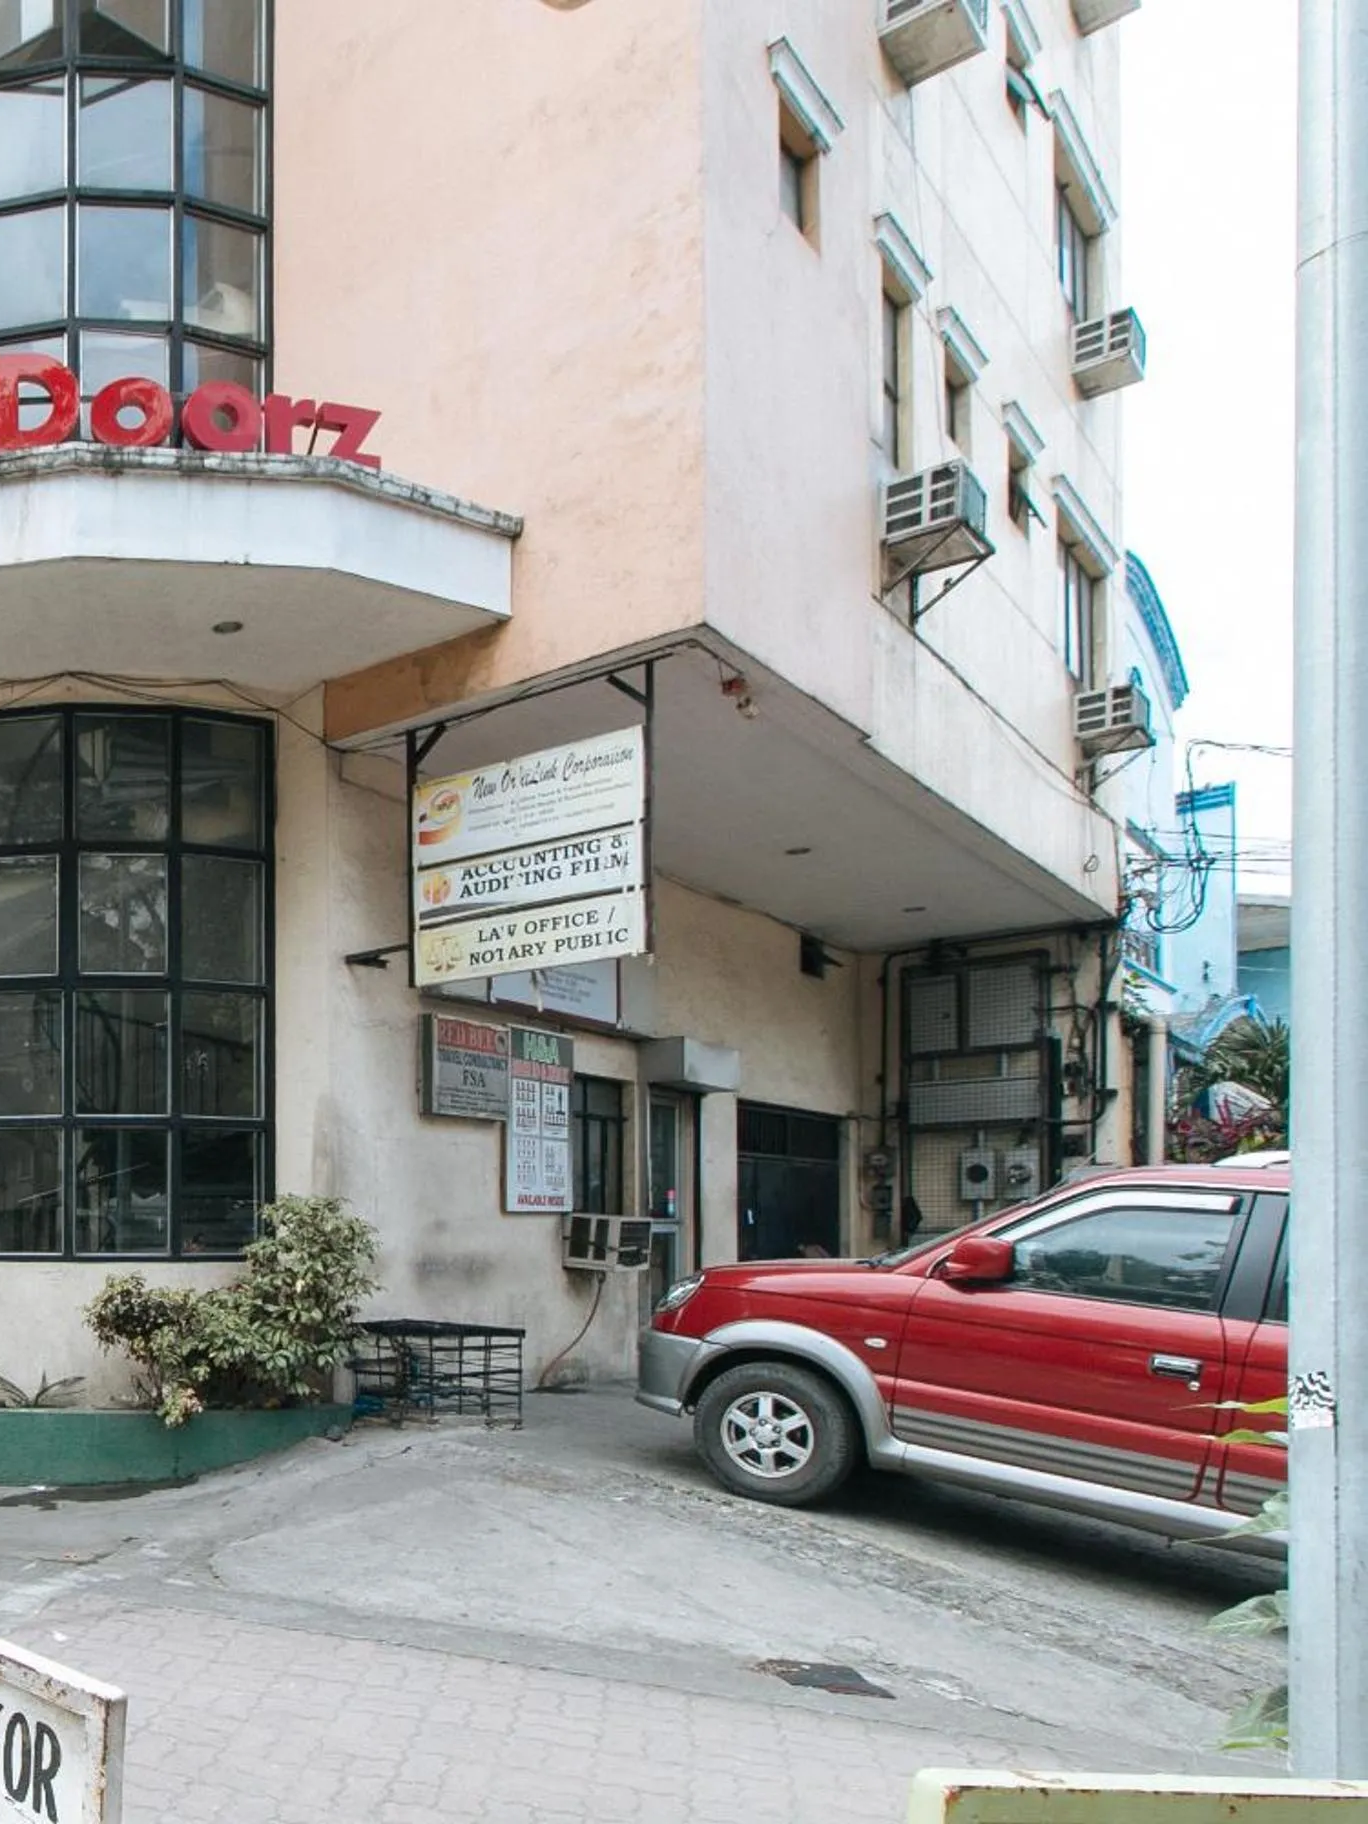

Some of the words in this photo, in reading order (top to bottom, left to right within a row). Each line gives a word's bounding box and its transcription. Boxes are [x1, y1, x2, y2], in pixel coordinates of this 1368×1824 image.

[461, 839, 601, 882] ACCOUNTING
[459, 865, 562, 898] AUDIING
[478, 923, 519, 943] LAW
[524, 909, 599, 935] OFFICE
[469, 942, 546, 967] NOTARY
[555, 928, 629, 953] PUBLIC
